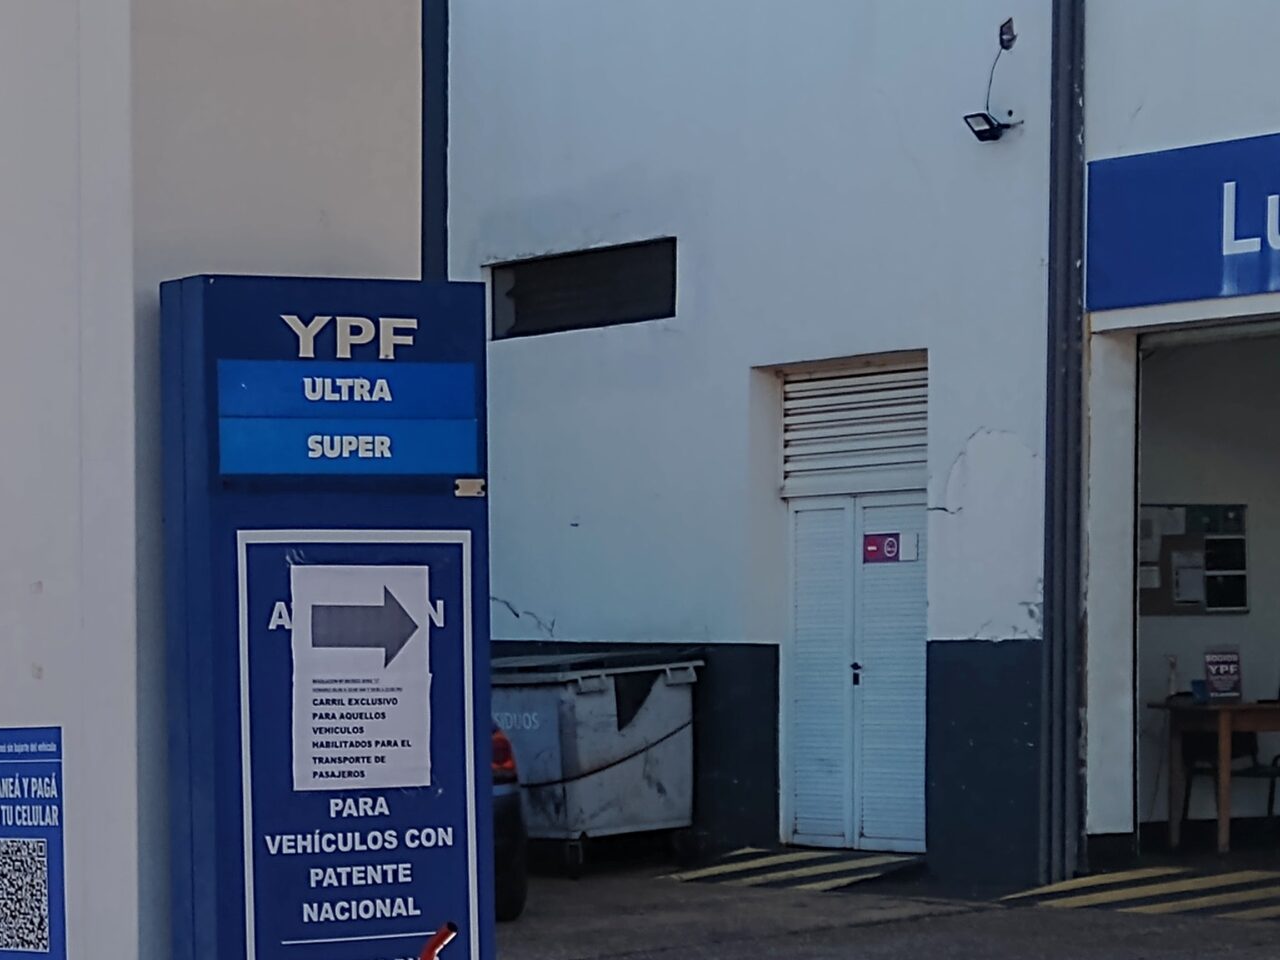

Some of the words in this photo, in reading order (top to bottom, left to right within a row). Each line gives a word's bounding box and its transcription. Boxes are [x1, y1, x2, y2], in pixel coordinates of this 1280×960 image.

[280, 314, 418, 360] YPF
[303, 377, 393, 401] ULTRA
[308, 435, 392, 458] SUPER
[1209, 664, 1238, 674] YPF
[312, 698, 346, 706] CARRIL
[348, 697, 398, 706] EXCLUSIVO
[312, 712, 337, 720] PARA
[339, 712, 386, 721] AQUELLOS
[312, 726, 365, 735] VEHICULOS
[312, 740, 372, 749] HABILITADOS
[374, 740, 399, 748] PARA
[401, 740, 412, 748] EL
[312, 756, 372, 764] TRANSPORTE
[374, 755, 386, 764] DE
[312, 770, 365, 779] PASAJEROS
[21, 777, 30, 798] Y
[31, 773, 58, 798] PAGÁ
[0, 805, 14, 826] TU
[15, 805, 59, 826] CELULAR
[329, 796, 390, 818] PARA
[265, 829, 398, 855] VEHÍCULOS
[404, 827, 453, 848] CON
[309, 863, 412, 888] PATENTE
[302, 897, 421, 923] NACIONAL
